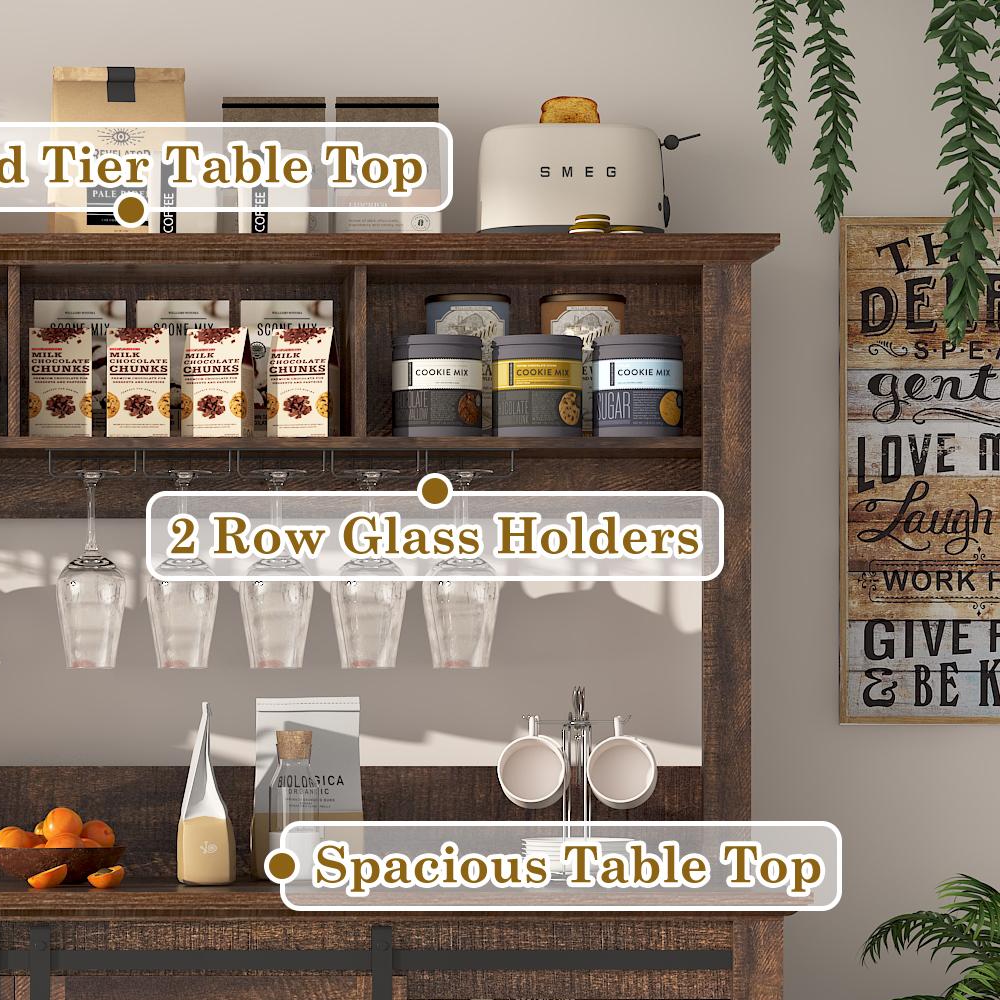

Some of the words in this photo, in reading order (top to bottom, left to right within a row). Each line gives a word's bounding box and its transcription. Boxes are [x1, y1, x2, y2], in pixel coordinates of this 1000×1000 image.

[540, 166, 617, 178] SMEG
[183, 365, 239, 374] CHUNKS
[269, 365, 325, 374] CHUNKS
[857, 433, 956, 494] LOVE
[852, 480, 994, 555] Laugh
[883, 570, 976, 592] WORK
[864, 619, 972, 660] GIVE
[862, 667, 898, 707] &
[913, 661, 960, 707] BE
